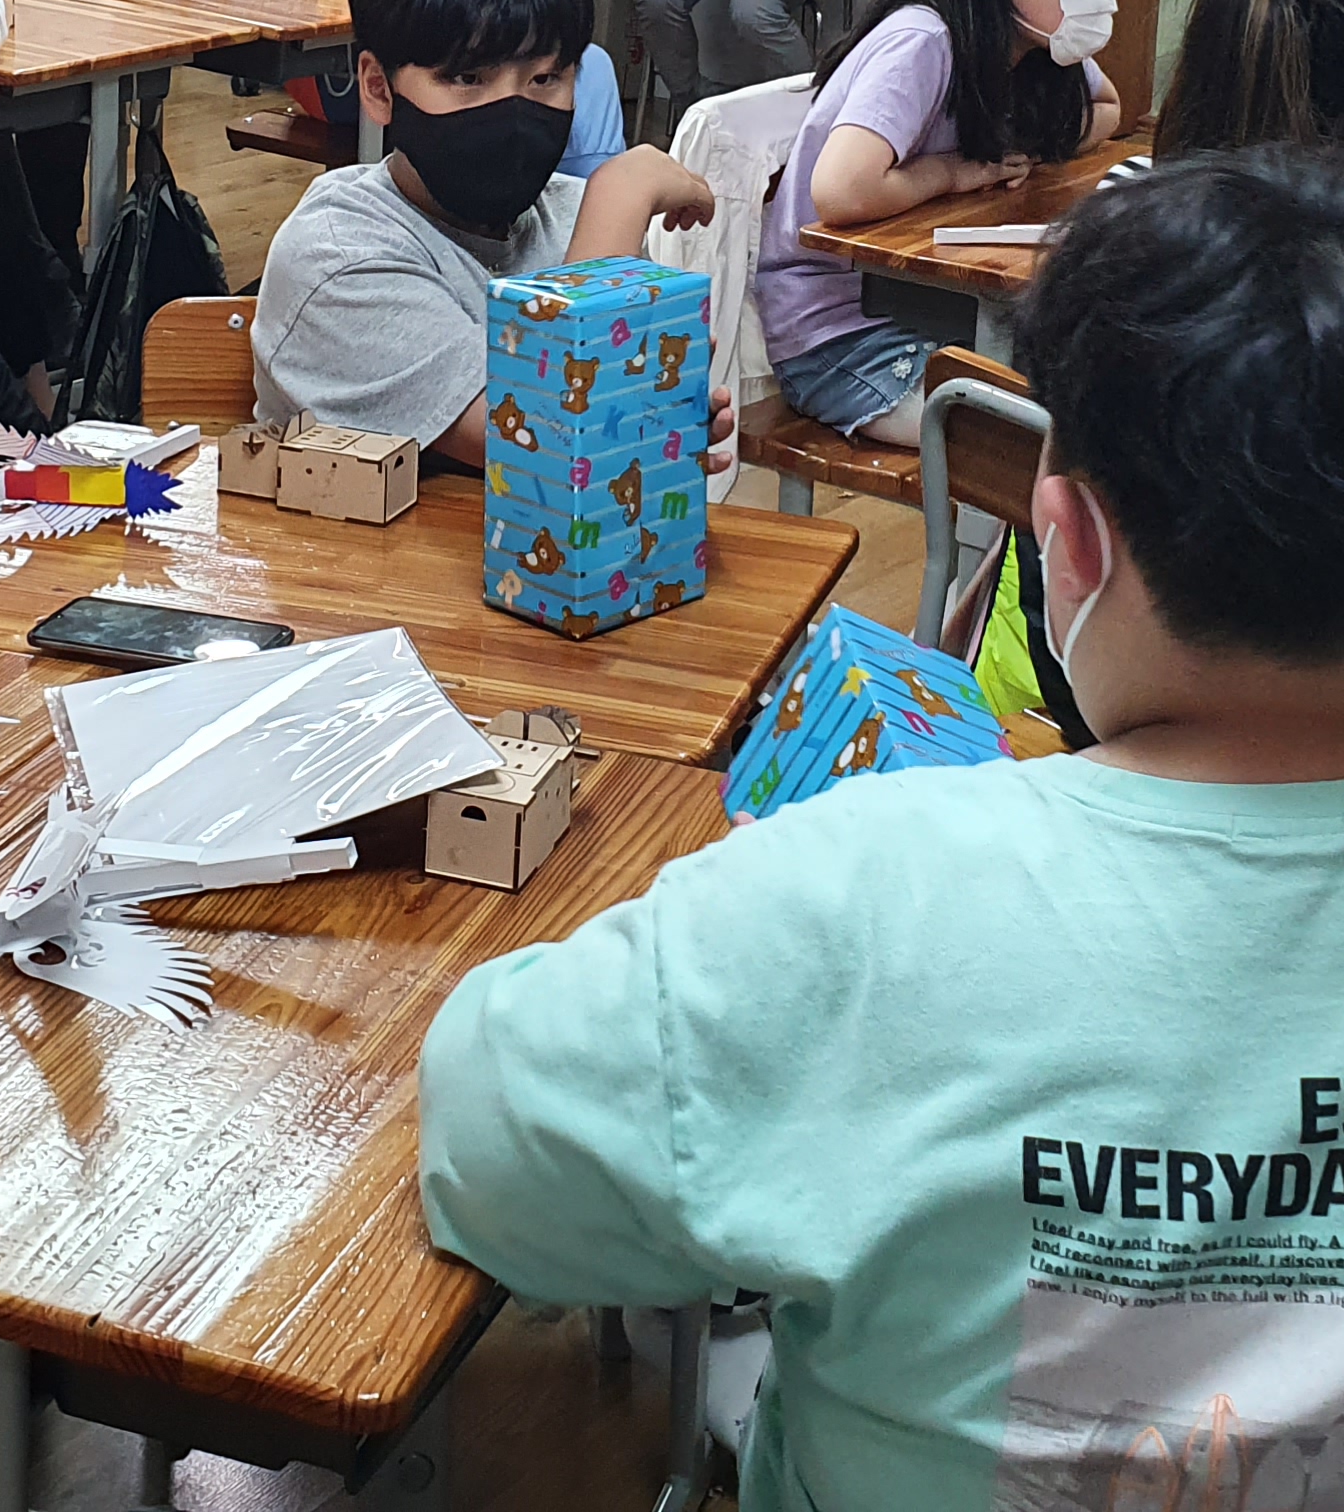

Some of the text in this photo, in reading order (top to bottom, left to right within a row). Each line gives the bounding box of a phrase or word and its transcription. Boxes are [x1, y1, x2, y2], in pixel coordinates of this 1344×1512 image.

[1077, 1231, 1115, 1251] easy
[1122, 1236, 1153, 1250] and
[1247, 1234, 1293, 1249] could
[1329, 1235, 1341, 1249] A
[1031, 1237, 1061, 1256] and
[1065, 1247, 1152, 1271] reconnect
[1082, 1287, 1129, 1308] enjoy
[1191, 1291, 1206, 1303] to
[1211, 1290, 1238, 1302] the
[1243, 1290, 1268, 1303] full
[1315, 1294, 1325, 1304] a
